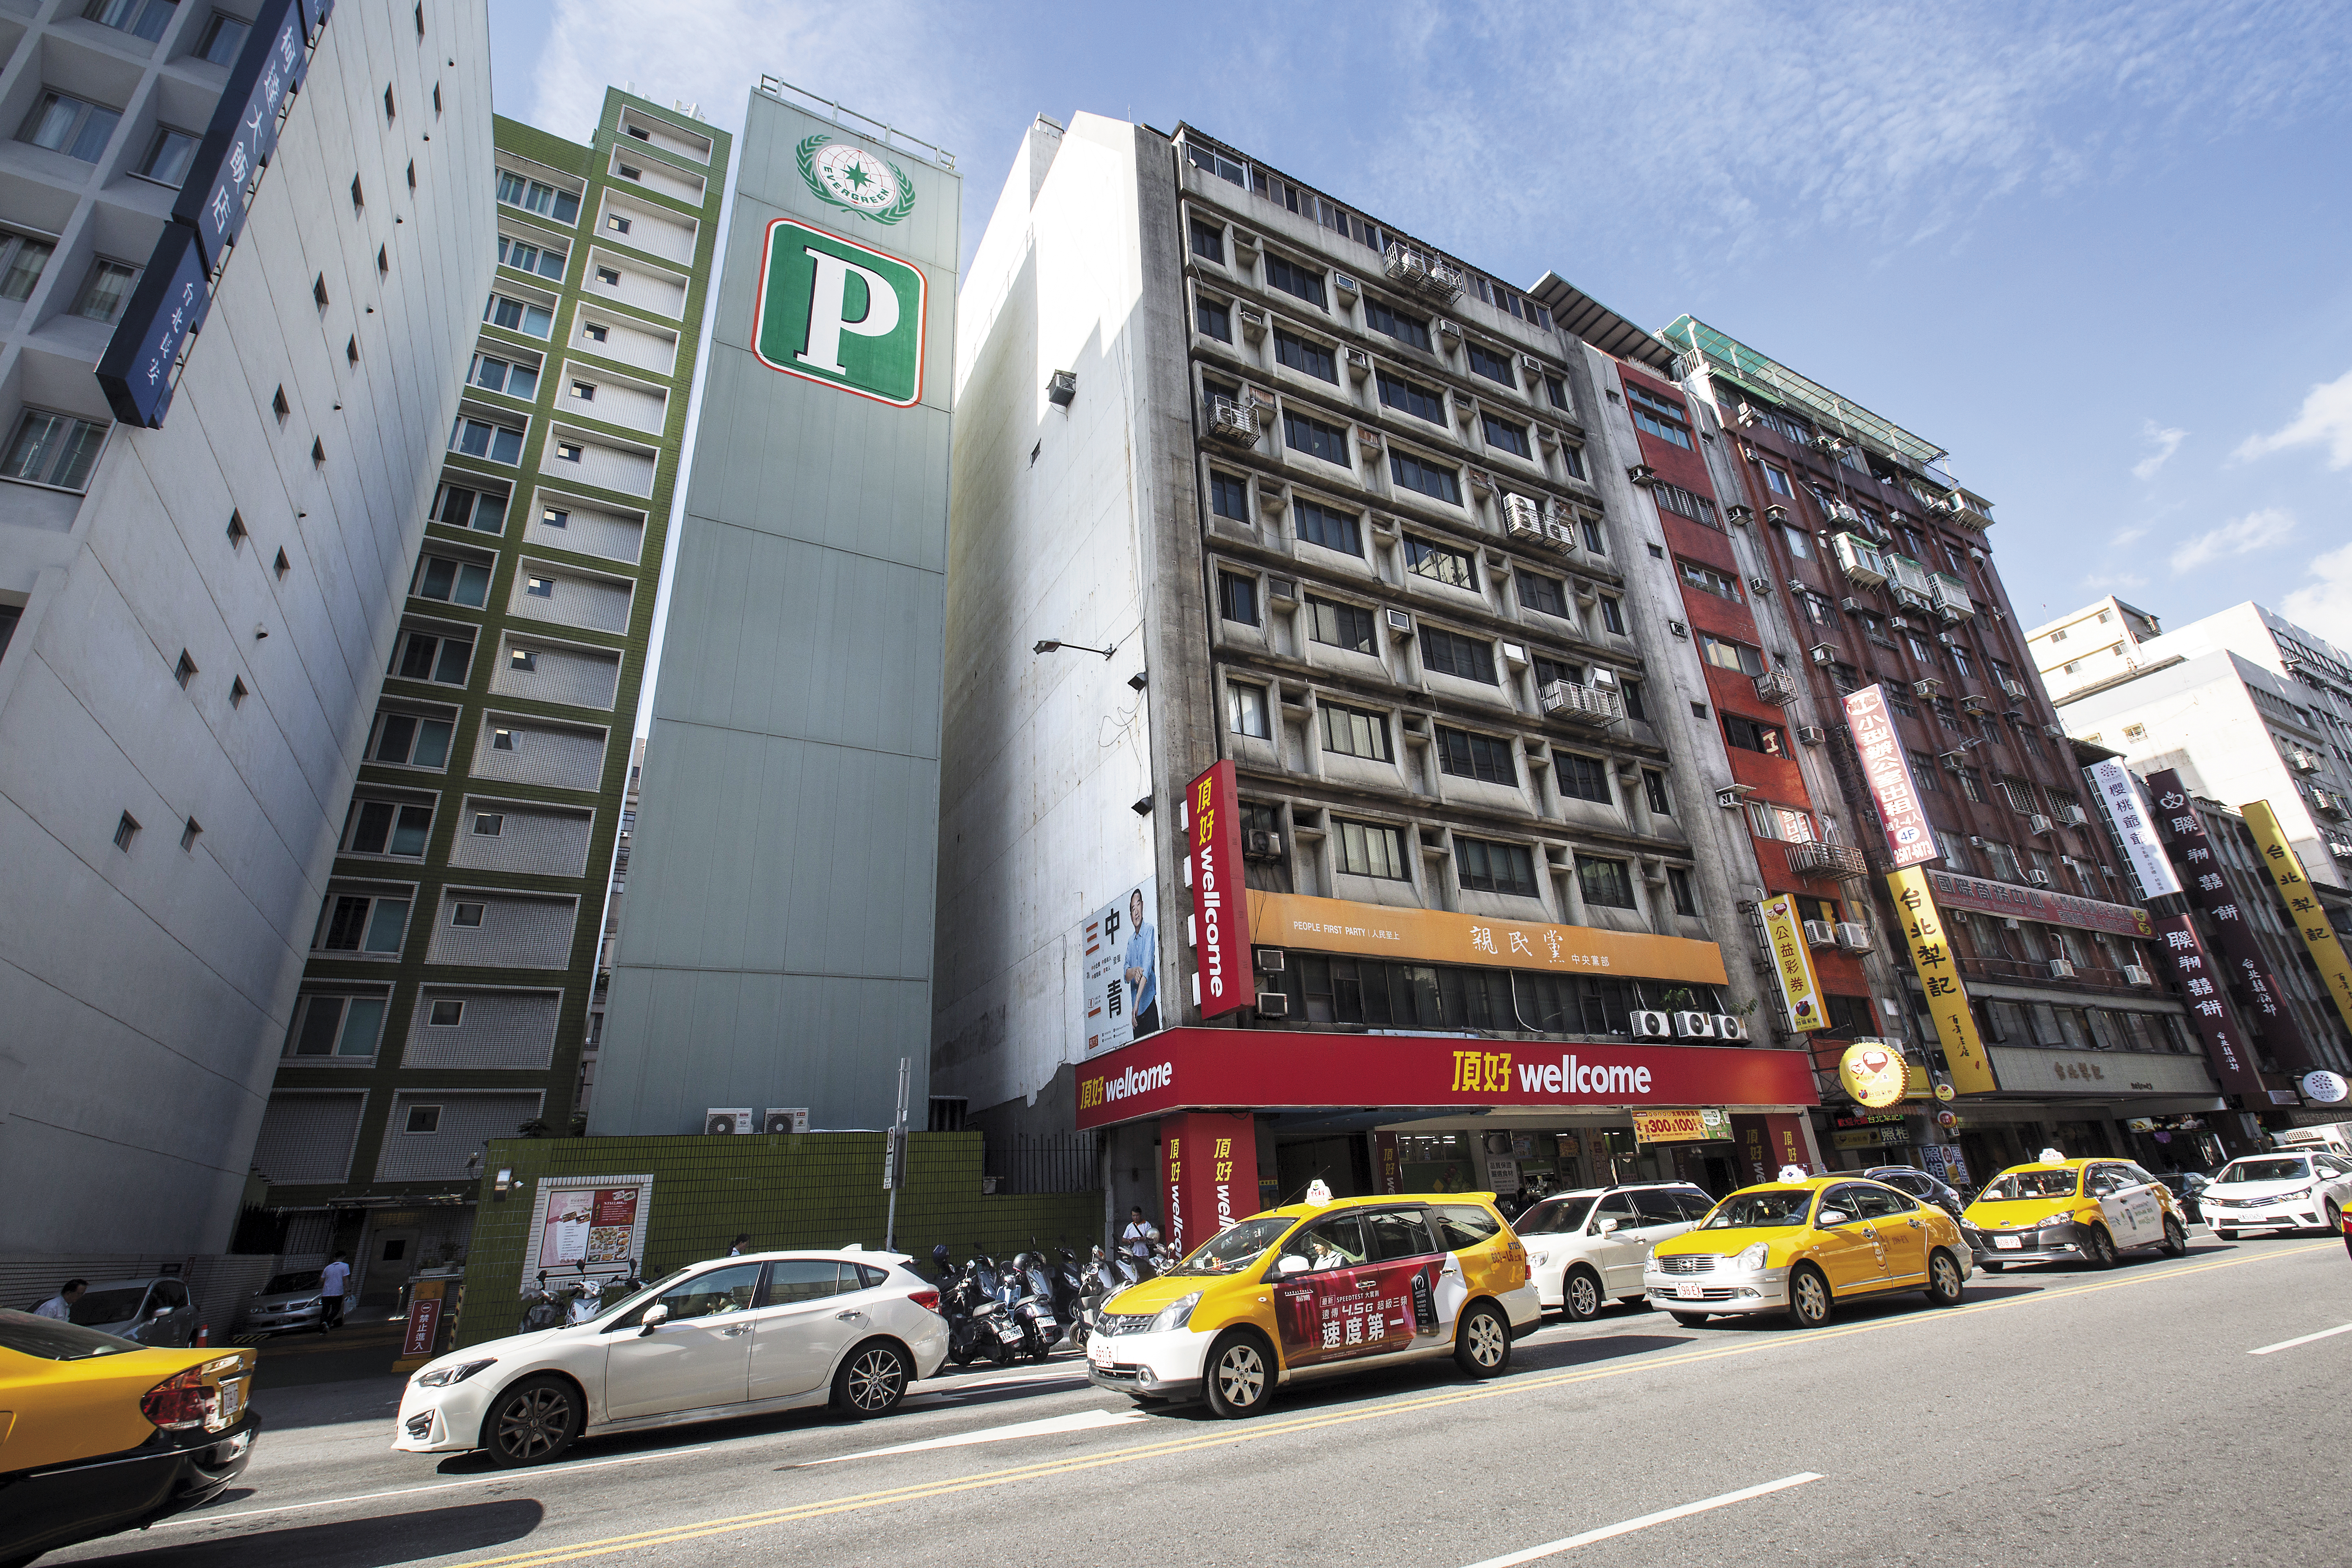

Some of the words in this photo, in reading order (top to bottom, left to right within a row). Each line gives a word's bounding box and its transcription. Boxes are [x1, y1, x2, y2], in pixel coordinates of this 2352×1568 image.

[824, 166, 889, 203] EVERGREEN
[793, 245, 899, 375] P
[1858, 715, 1914, 817] 小型辦公室出租
[2101, 774, 2122, 783] CHERRY
[1197, 776, 1214, 846] 頂好
[2109, 782, 2146, 845] 櫻桃爺爺
[1900, 829, 1915, 841] 4F
[1927, 870, 2045, 909] 國際商務中心
[2266, 844, 2330, 941] 台北犁記
[1200, 845, 1223, 998] wellcome
[1294, 921, 1321, 932] PEOPLE
[1323, 924, 1342, 934] FIRST
[1345, 927, 1365, 936] PARTY
[1372, 929, 1400, 940] 人民至上
[1470, 926, 1565, 963] 親民黨
[1572, 953, 1610, 967] 中央黨部
[1776, 925, 1804, 992] 公益彩券
[1900, 887, 1956, 998] 台北犁記
[1080, 1076, 1104, 1109] 頂好
[1106, 1062, 1172, 1102] wellcome
[1452, 1051, 1511, 1091] 頂好
[1518, 1054, 1651, 1093] wellcome
[1746, 1129, 1762, 1160] 頂好
[1783, 1131, 1797, 1162] 頂好
[1881, 1127, 1909, 1141] 照相
[1170, 1138, 1180, 1182] 頂好
[1214, 1138, 1233, 1181] 頂好
[1384, 1148, 1395, 1176] 頂好
[1924, 1147, 1946, 1178] 照相
[1951, 1146, 1968, 1176] 照相
[1491, 1250, 1514, 1263] 683-L6
[1508, 1242, 1520, 1250] 8729
[1322, 1297, 1333, 1305] 最新
[1336, 1293, 1363, 1303] SPEEDTEST
[1365, 1290, 1379, 1298] 大實測
[1322, 1307, 1338, 1320] 遠傳
[1342, 1302, 1373, 1316] 4.5G
[1377, 1296, 1407, 1310] 超級三頻
[413, 1314, 429, 1350] 禁止進入
[1322, 1313, 1404, 1350] 速度第一
